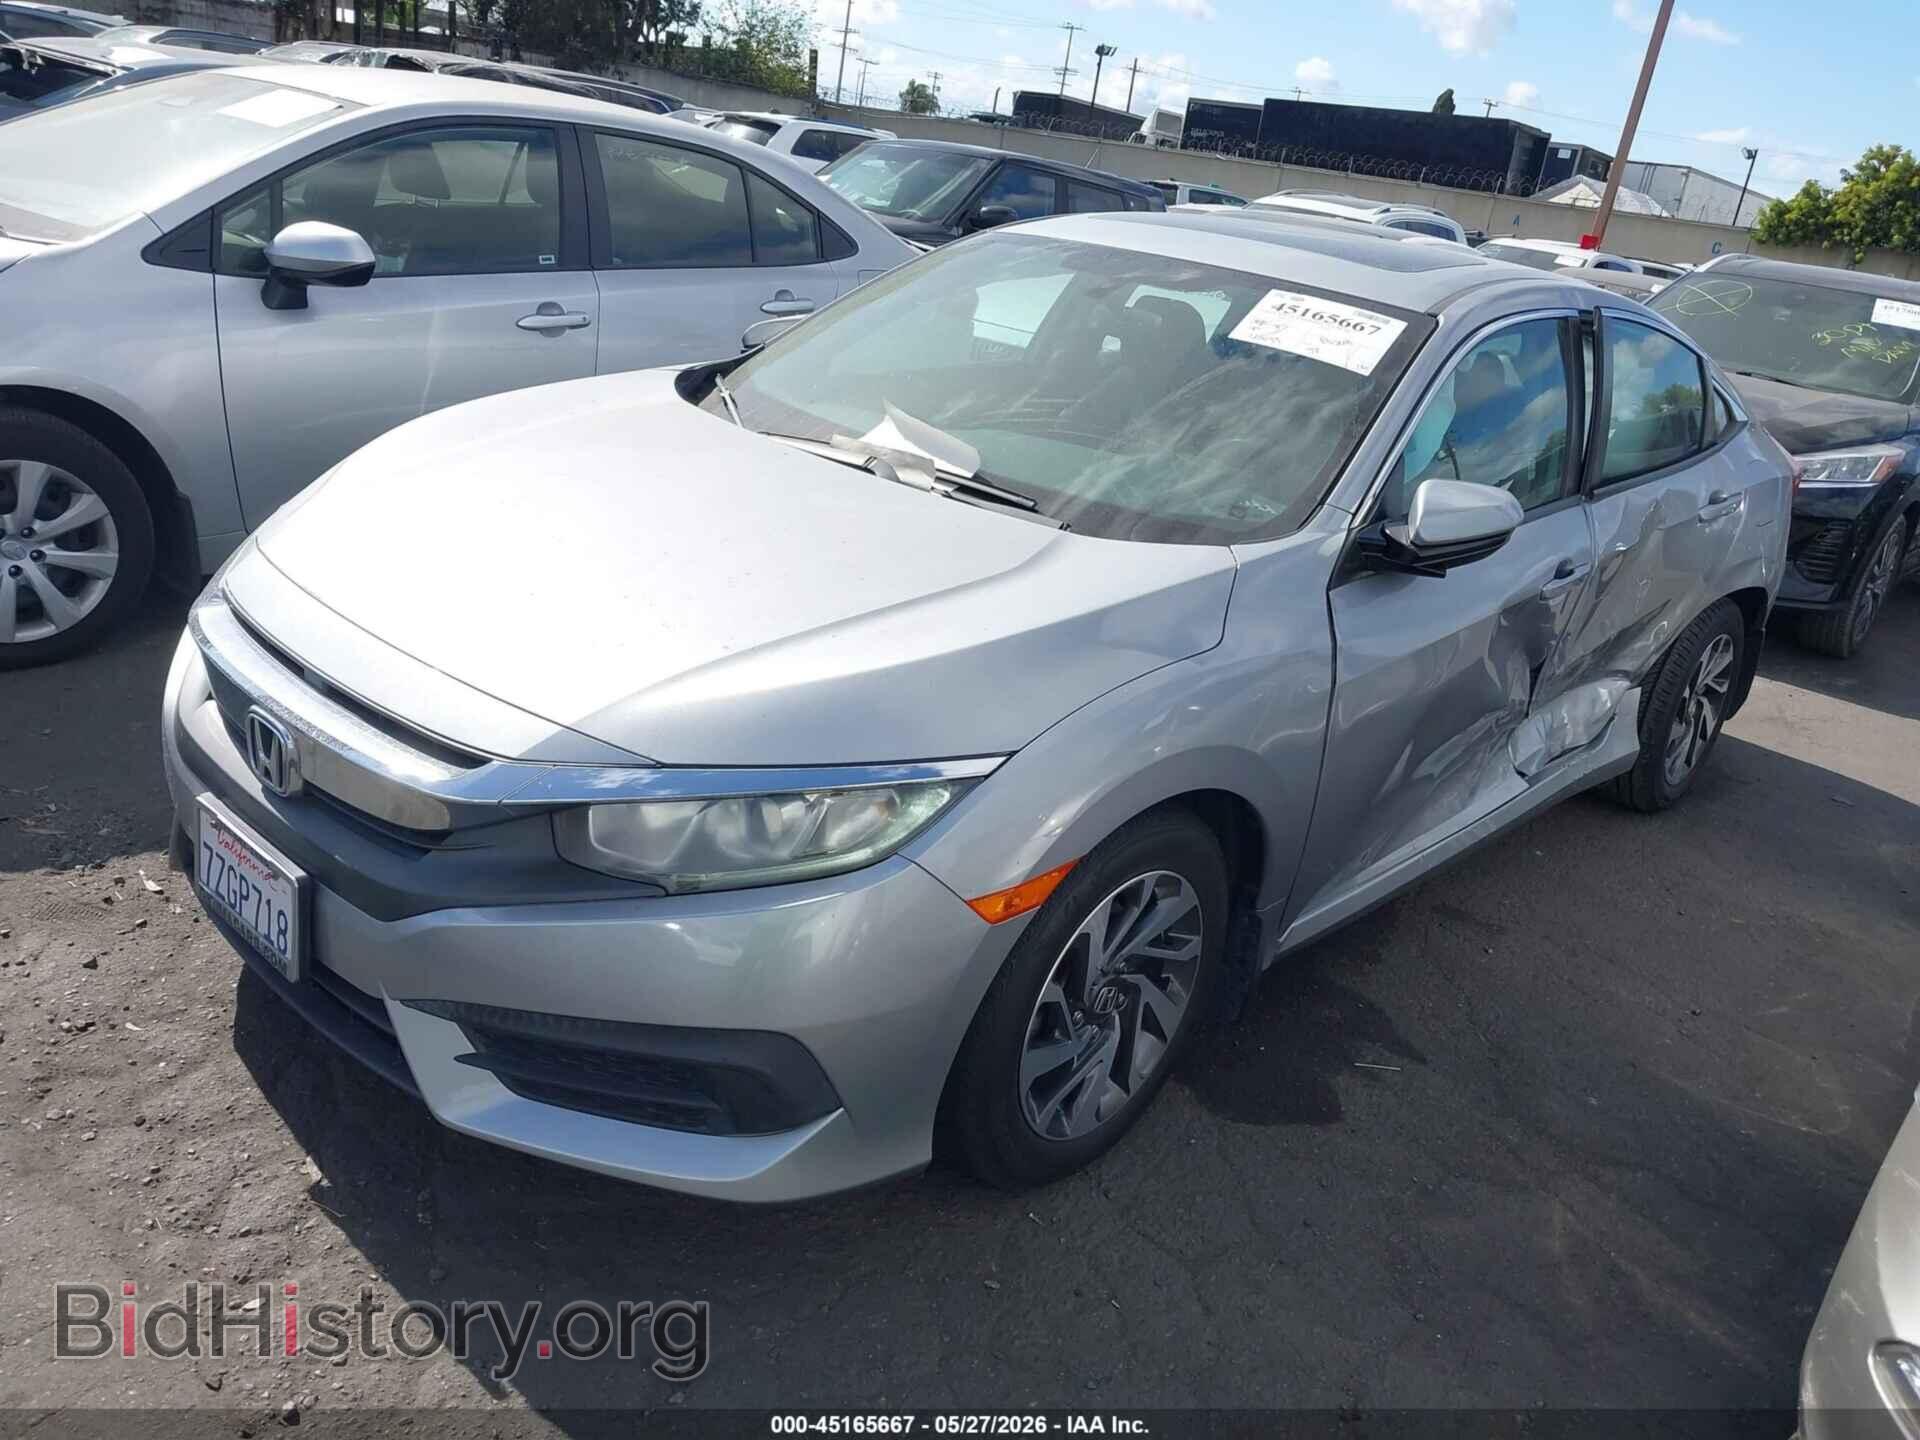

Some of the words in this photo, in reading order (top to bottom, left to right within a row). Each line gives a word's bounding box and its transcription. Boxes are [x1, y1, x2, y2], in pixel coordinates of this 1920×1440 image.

[1711, 241, 1722, 255] C
[1271, 302, 1382, 336] 45165667
[216, 829, 274, 882] California
[203, 841, 288, 956] 7ZGP718
